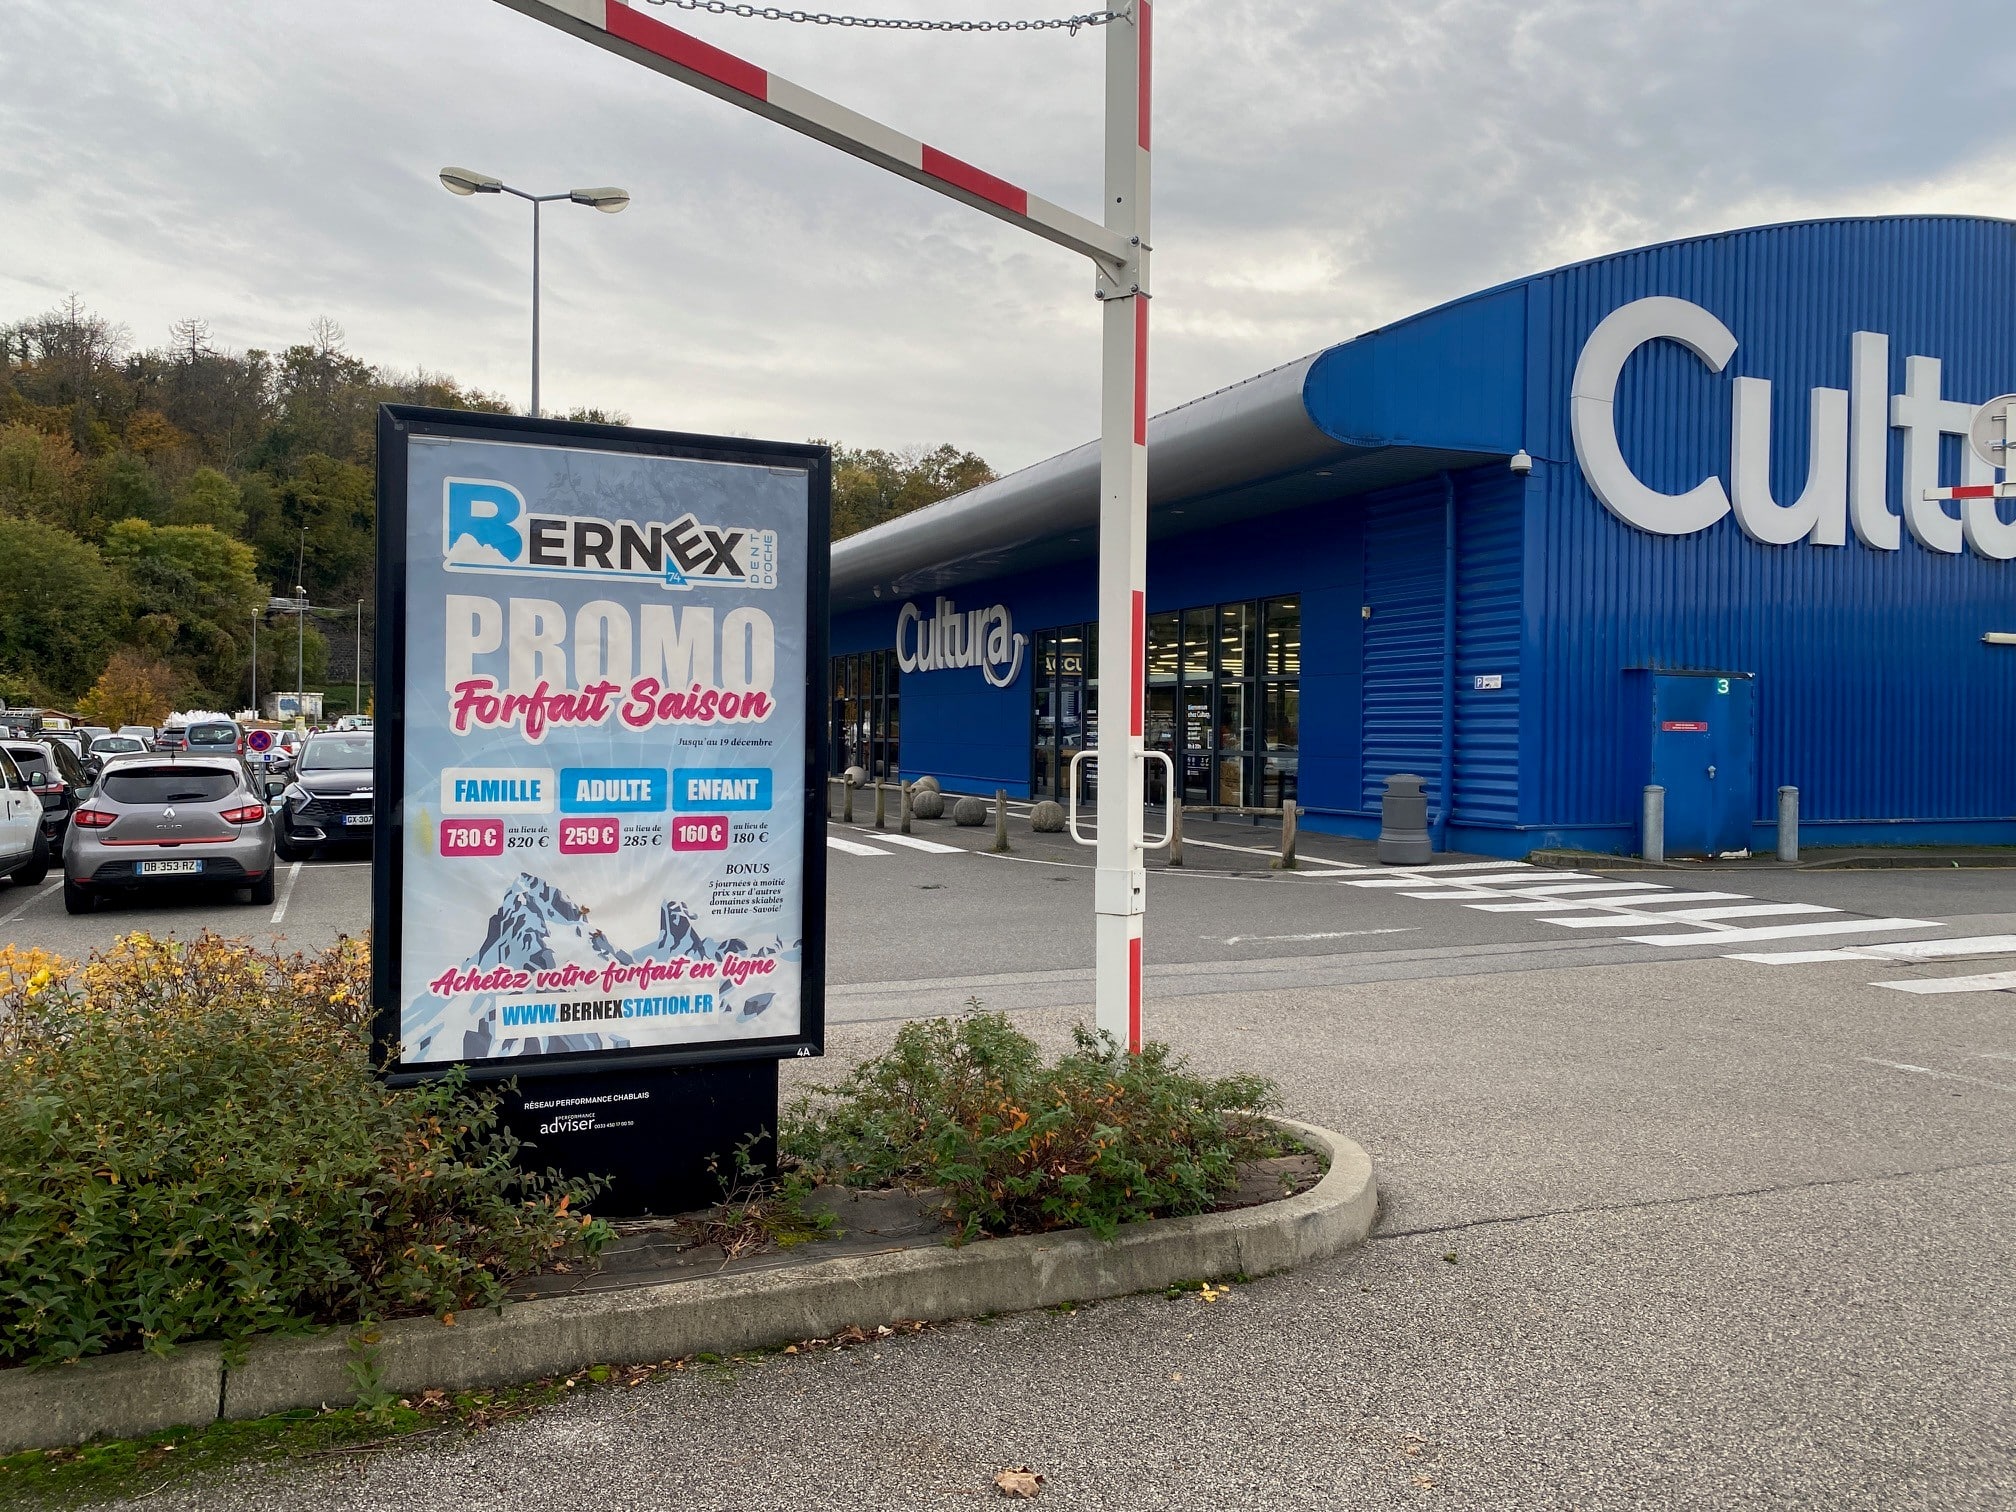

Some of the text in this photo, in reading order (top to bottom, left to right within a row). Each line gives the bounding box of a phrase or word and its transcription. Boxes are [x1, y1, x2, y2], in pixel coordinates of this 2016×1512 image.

[448, 482, 745, 577] BERNEX
[751, 533, 760, 583] DENT
[764, 535, 773, 584] D'OCHE
[667, 571, 681, 583] 74
[445, 594, 775, 692] PROMO
[896, 596, 1029, 688] Cultura
[1717, 679, 1729, 693] 3
[454, 677, 771, 740] Forfait Saison
[678, 737, 773, 748] Jusqu'au 19 décembre
[455, 779, 541, 803] FAMILLE
[576, 779, 651, 802] ADULTE
[687, 778, 759, 801] ENFANT
[520, 826, 537, 834] lieu
[635, 825, 651, 833] lieu
[678, 824, 722, 843] 160 €
[759, 822, 768, 830] de
[447, 828, 497, 848] 730 €
[507, 836, 549, 848] 820 €
[565, 826, 614, 846] 259 €
[623, 834, 662, 847] 285 €
[733, 832, 769, 844] 180 €
[725, 863, 770, 875] BONUS
[708, 880, 714, 888] 5
[715, 879, 751, 889] journées
[760, 878, 786, 887] moitié
[709, 896, 784, 906] domaines skiables
[712, 890, 730, 901] prix
[747, 887, 782, 896] d'autres
[430, 954, 777, 996] Achetez votre forfait en ligne
[502, 994, 713, 1027] WWW.BERNEXSTATION.FR
[796, 1047, 811, 1057] 4A
[524, 1091, 650, 1110] RÉSEAU PERFORMANCE CHABLAIS
[540, 1116, 596, 1134] adviser
[557, 1112, 596, 1121] PERFORMANCE
